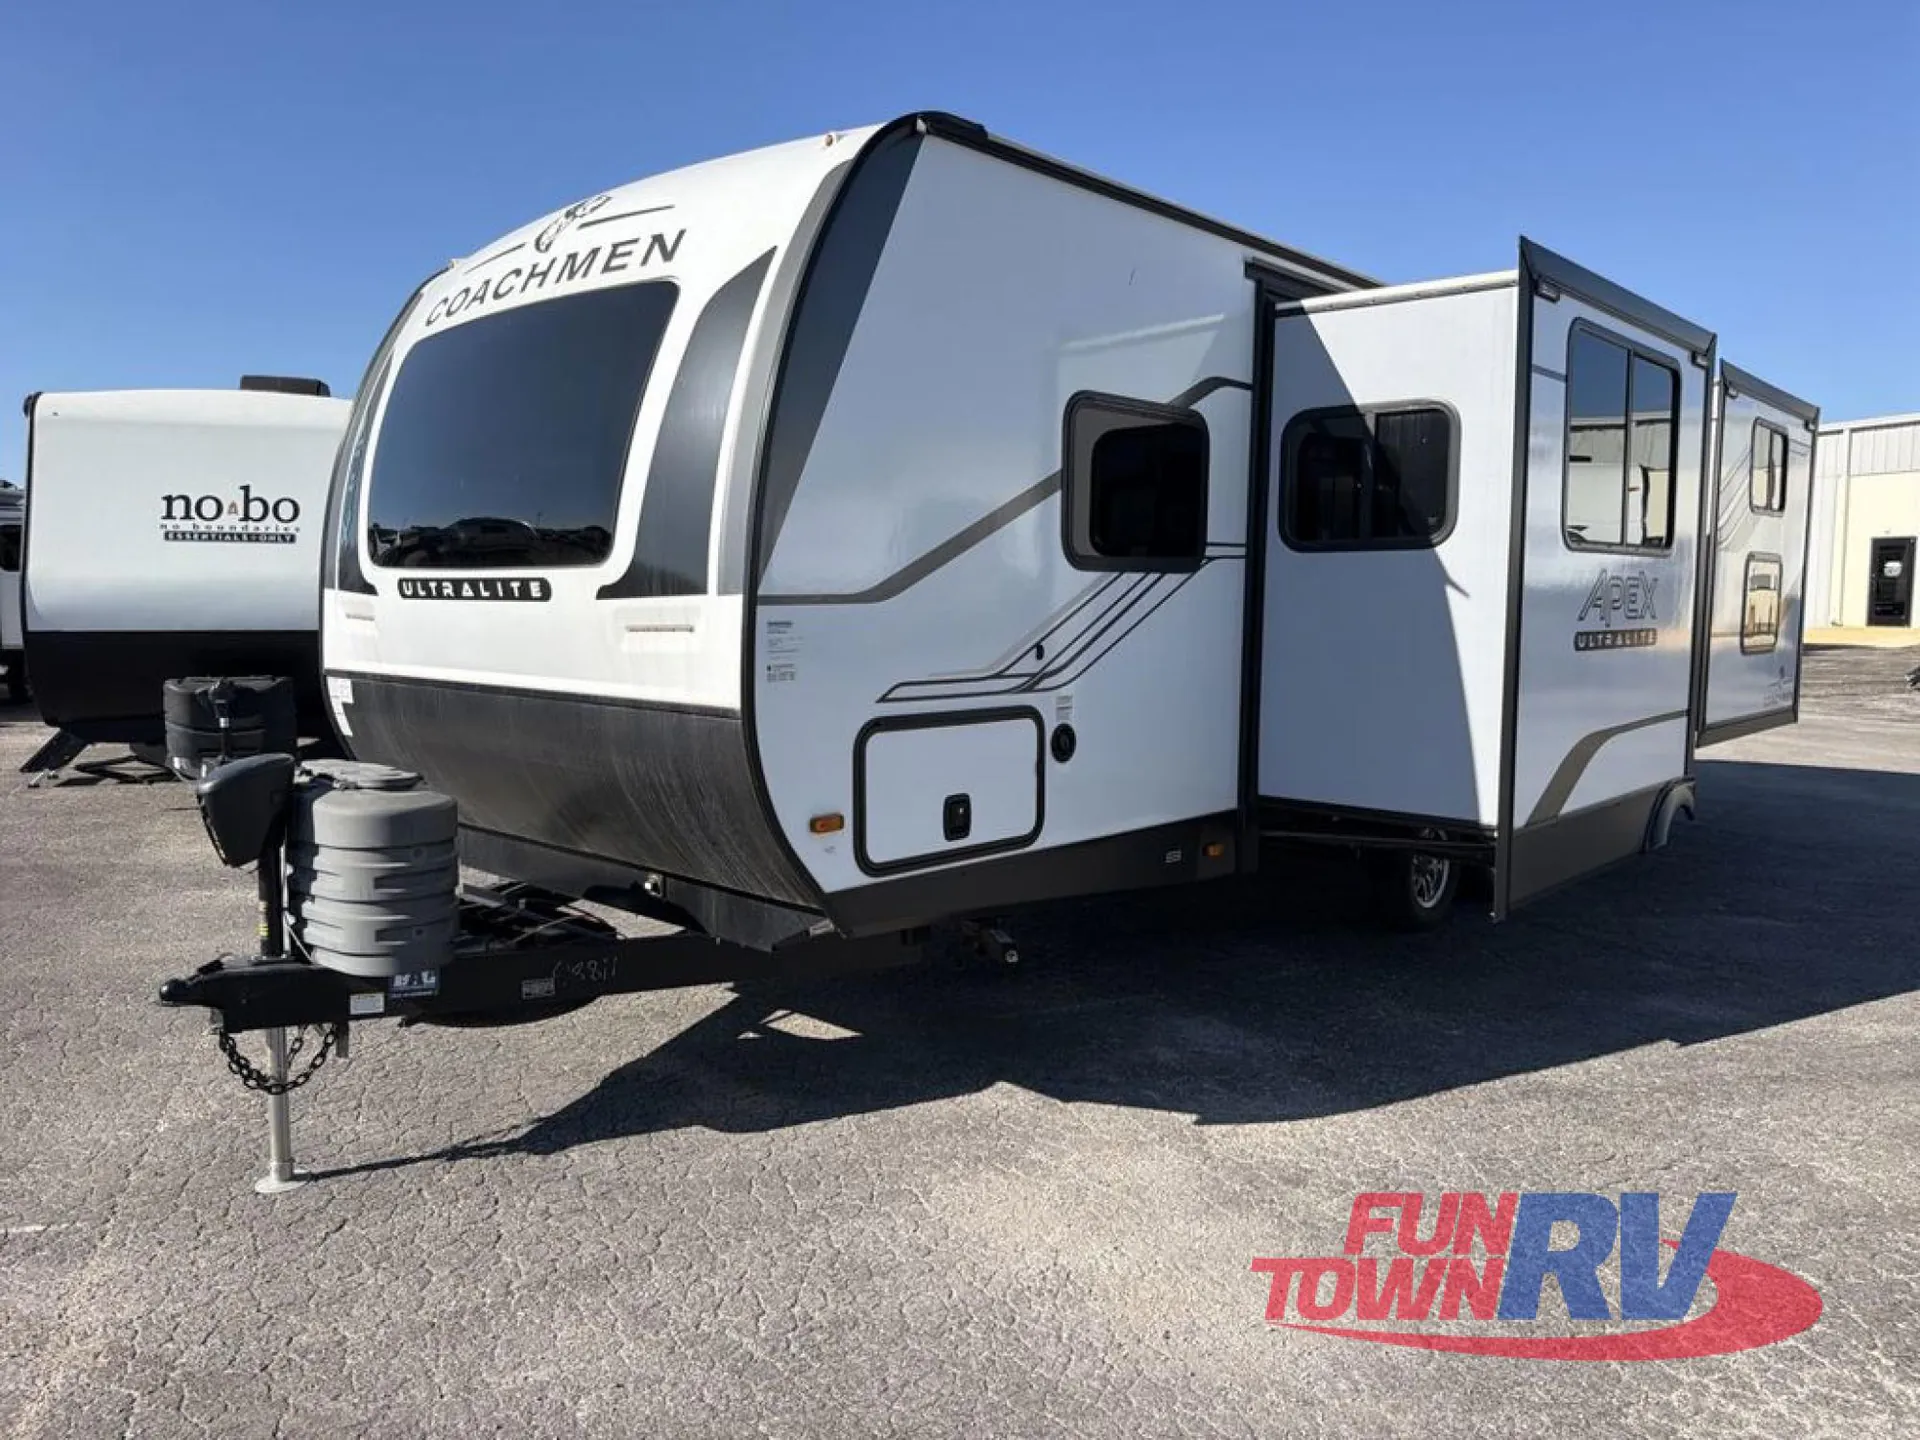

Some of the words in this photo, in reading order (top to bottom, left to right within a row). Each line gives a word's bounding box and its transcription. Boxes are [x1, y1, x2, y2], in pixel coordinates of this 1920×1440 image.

[426, 229, 687, 327] COACHMEN
[402, 580, 543, 598] ULTRALITE
[1577, 568, 1659, 628] APEX
